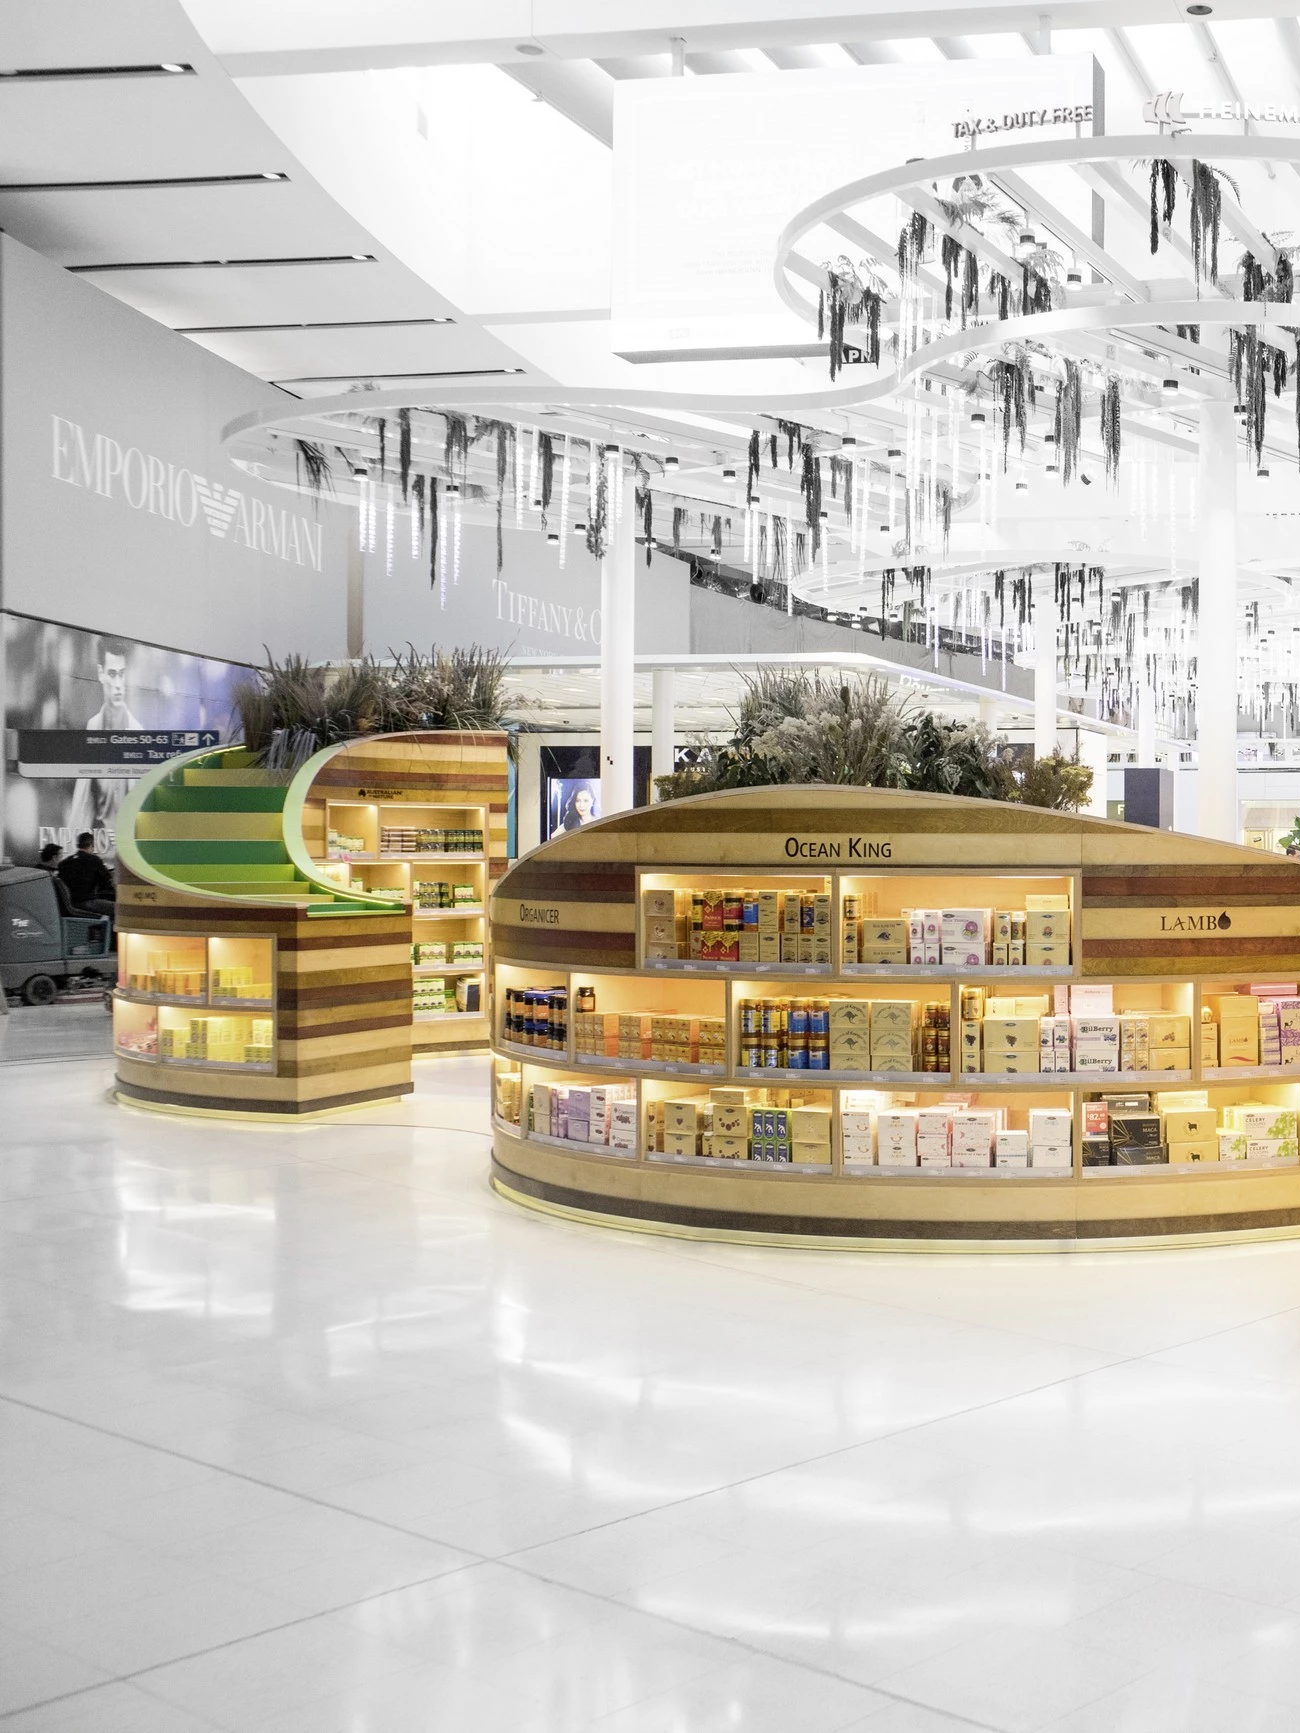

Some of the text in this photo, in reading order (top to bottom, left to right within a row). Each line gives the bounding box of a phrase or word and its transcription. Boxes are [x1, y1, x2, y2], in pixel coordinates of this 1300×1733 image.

[951, 120, 982, 139] TAX
[1002, 109, 1049, 130] DUTY
[1053, 104, 1094, 125] FREE
[51, 414, 323, 573] EMPORIO ARMANI
[110, 735, 169, 744] Gates 50-63
[146, 750, 164, 759] Tax
[785, 837, 892, 858] OCEAN KING
[520, 903, 560, 924] ORGANICER
